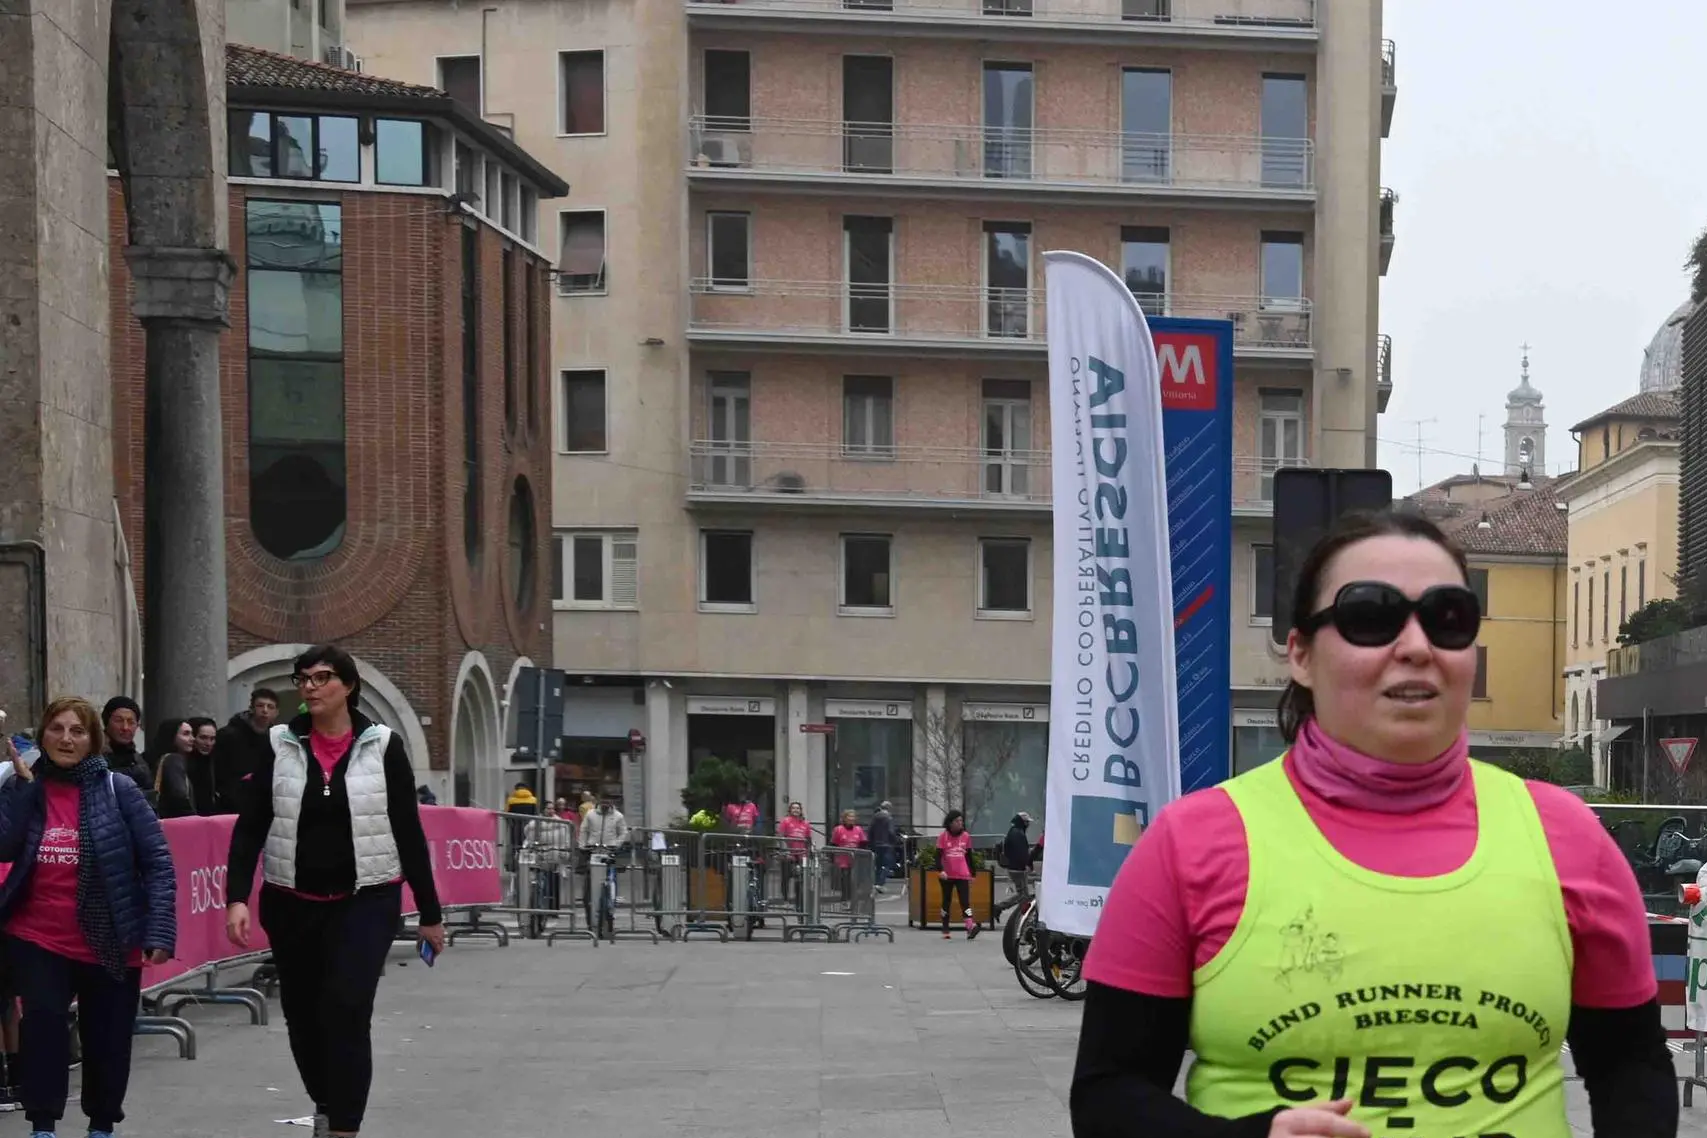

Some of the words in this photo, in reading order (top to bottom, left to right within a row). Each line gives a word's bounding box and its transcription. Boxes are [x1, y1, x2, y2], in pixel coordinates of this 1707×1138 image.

[39, 845, 80, 854] COTONELL
[1247, 1001, 1323, 1052] BLIND
[1335, 983, 1463, 1010] RUNNER
[1353, 1008, 1479, 1031] BRESCIA
[1268, 1054, 1528, 1108] CIECO
